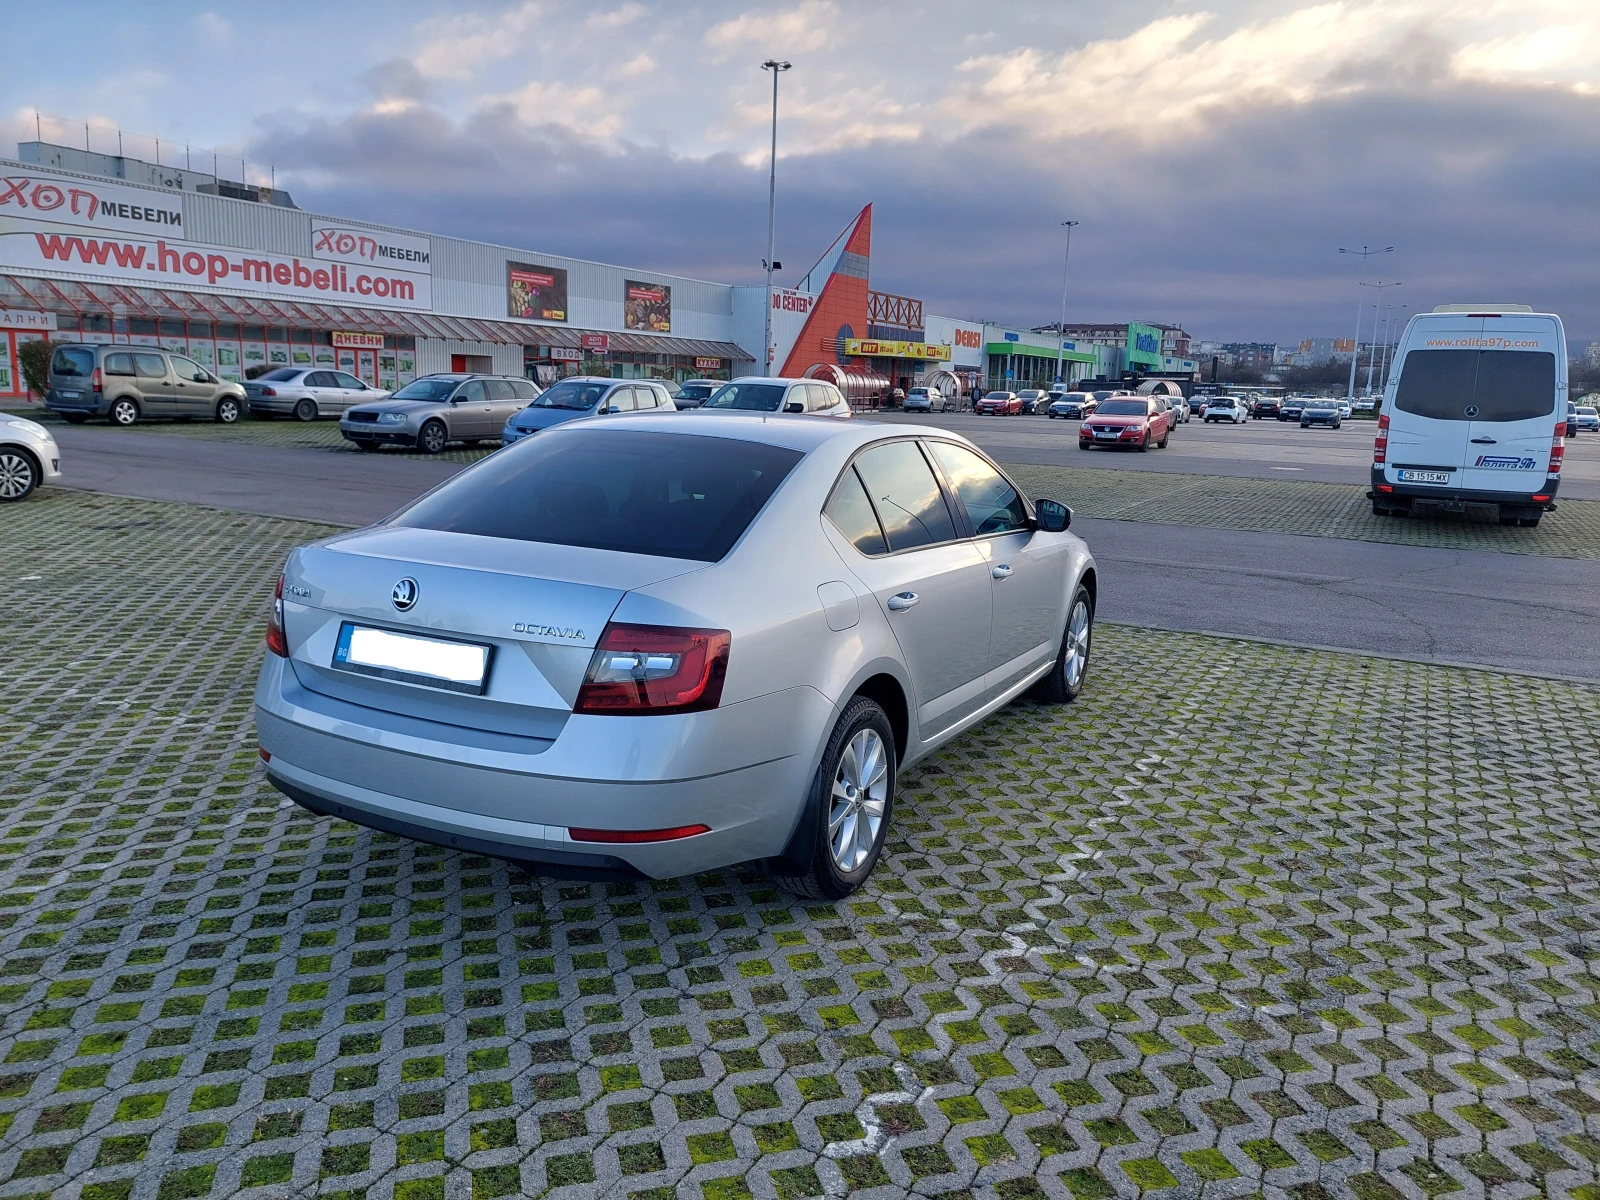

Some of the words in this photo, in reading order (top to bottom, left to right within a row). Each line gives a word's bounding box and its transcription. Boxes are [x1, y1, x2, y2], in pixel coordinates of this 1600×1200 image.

[101, 200, 182, 226] МЕБЕЛИ
[378, 245, 430, 264] МЕБЕЛИ
[35, 233, 415, 301] www.hop-mebeli.com
[782, 295, 808, 313] CENTER
[335, 333, 383, 346] ДНЕВНИ
[954, 328, 981, 349] DENSI
[1426, 337, 1539, 349] www.rolita97p.com
[556, 349, 580, 359] ВХОД
[862, 343, 877, 353] HIT
[697, 358, 720, 368] КУХНИ
[1403, 471, 1415, 480] CB
[1417, 472, 1435, 481] 1515
[1436, 473, 1448, 482] MX
[512, 621, 586, 640] OCTAVIA
[337, 647, 348, 657] BG
